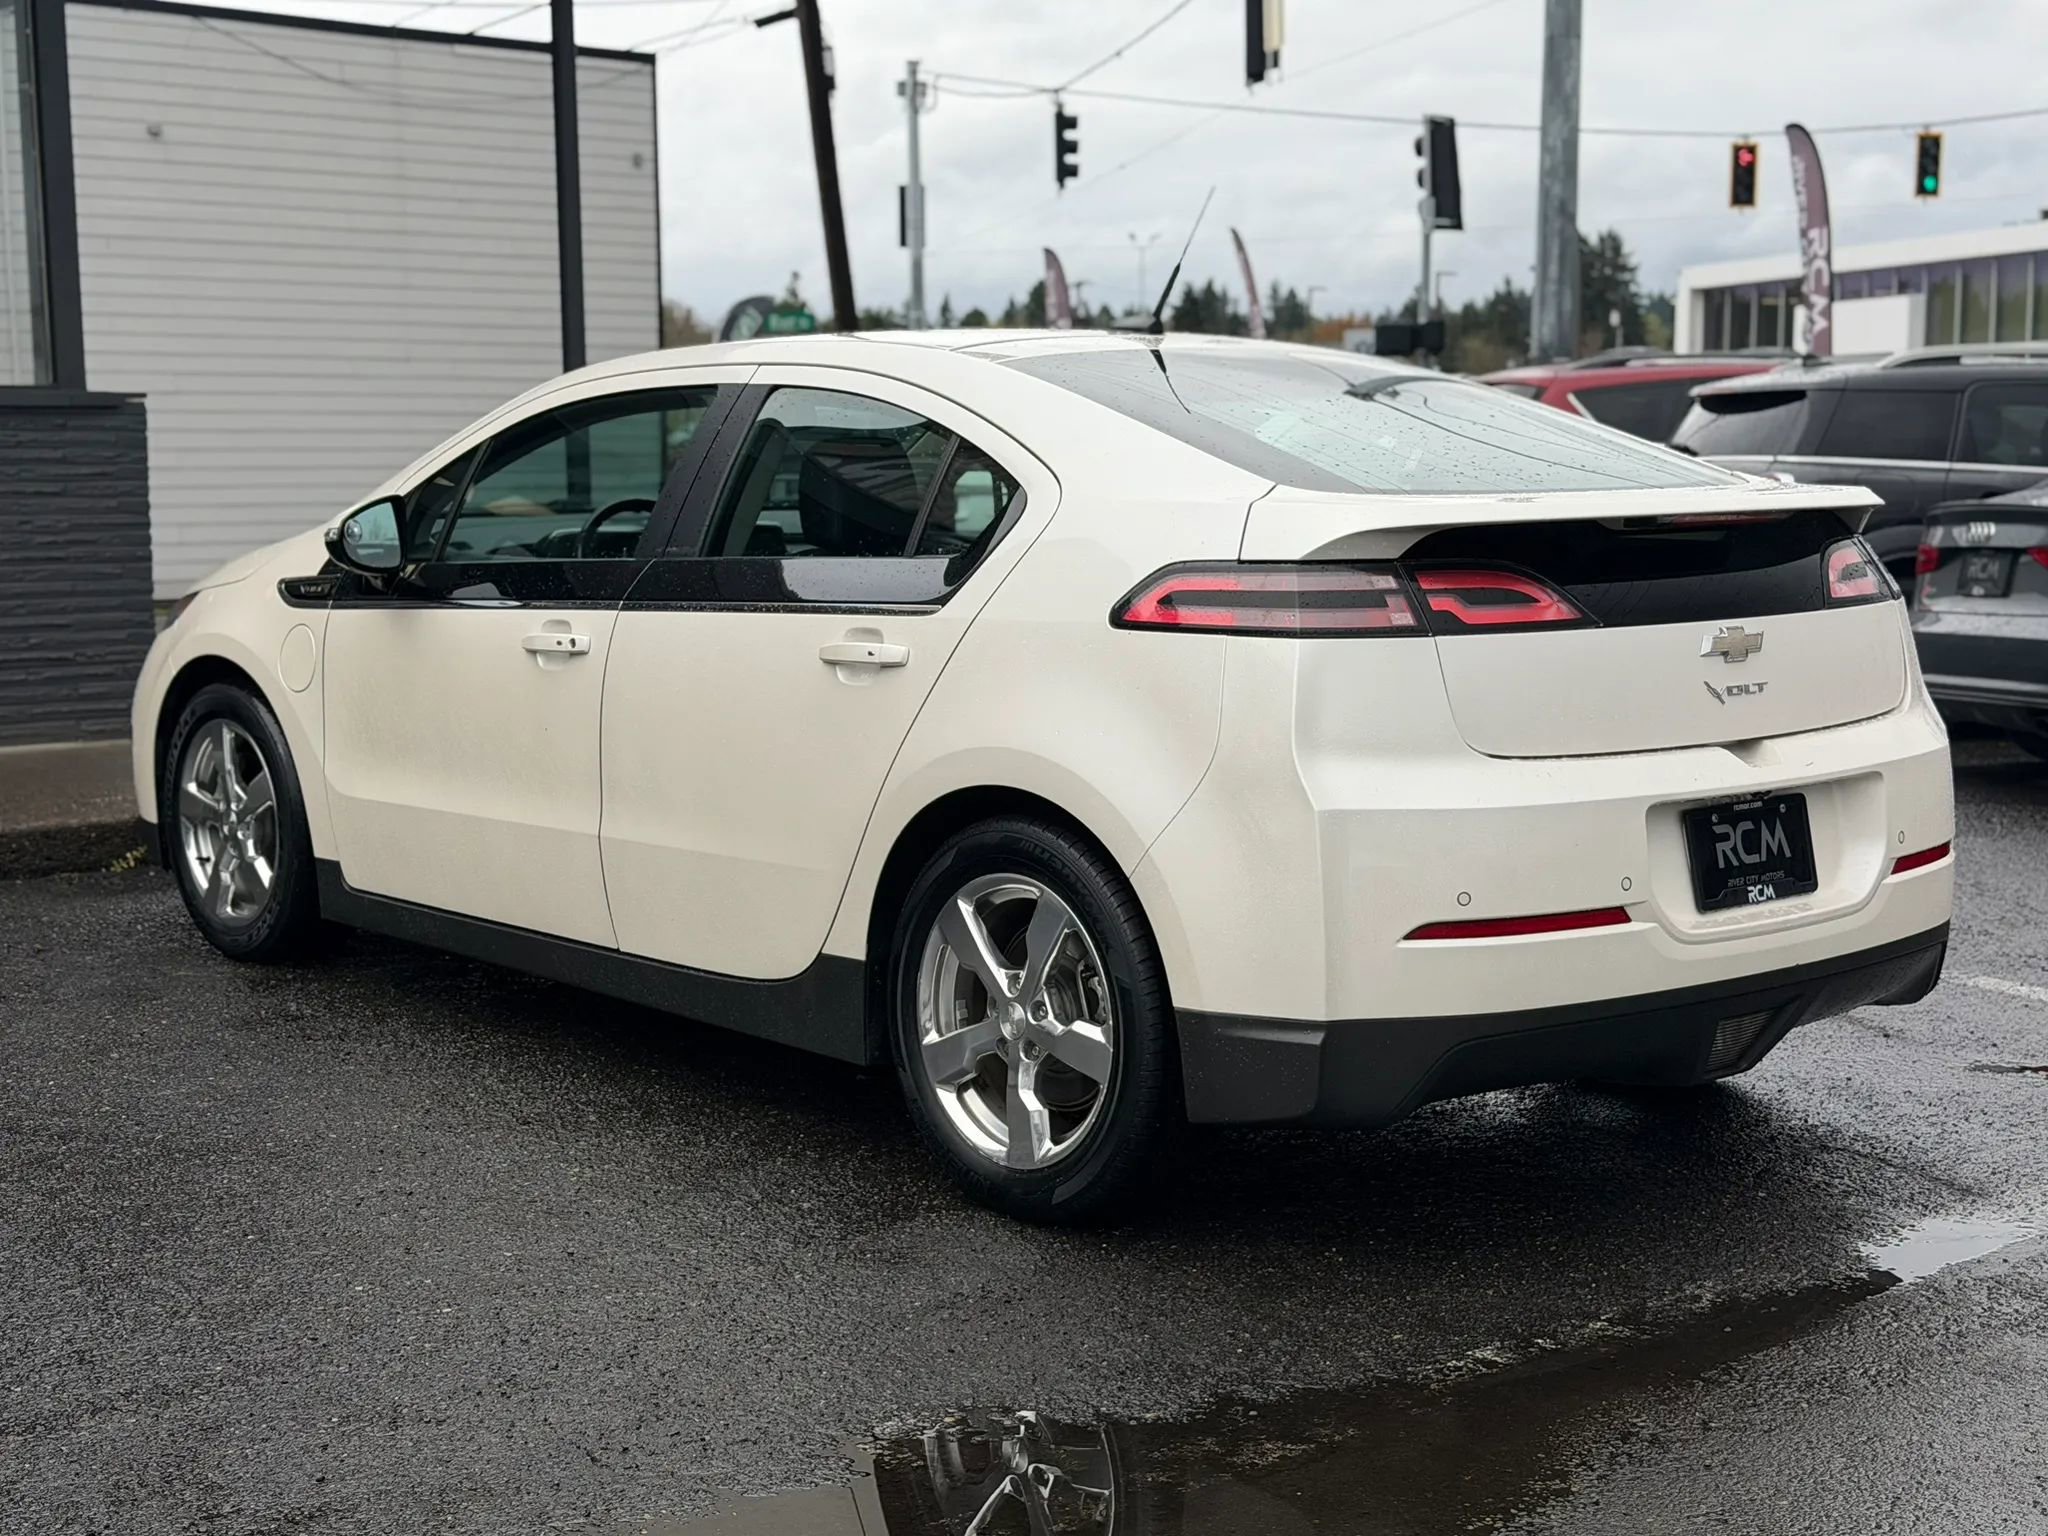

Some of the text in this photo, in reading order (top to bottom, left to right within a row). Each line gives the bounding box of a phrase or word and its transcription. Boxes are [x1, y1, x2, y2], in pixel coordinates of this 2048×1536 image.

[1807, 226, 1829, 335] RCM
[1703, 680, 1768, 705] VOLT
[1712, 816, 1792, 869] RCM
[1746, 874, 1759, 885] CITY
[1761, 870, 1785, 883] MOTORS
[1747, 883, 1776, 903] RCM
